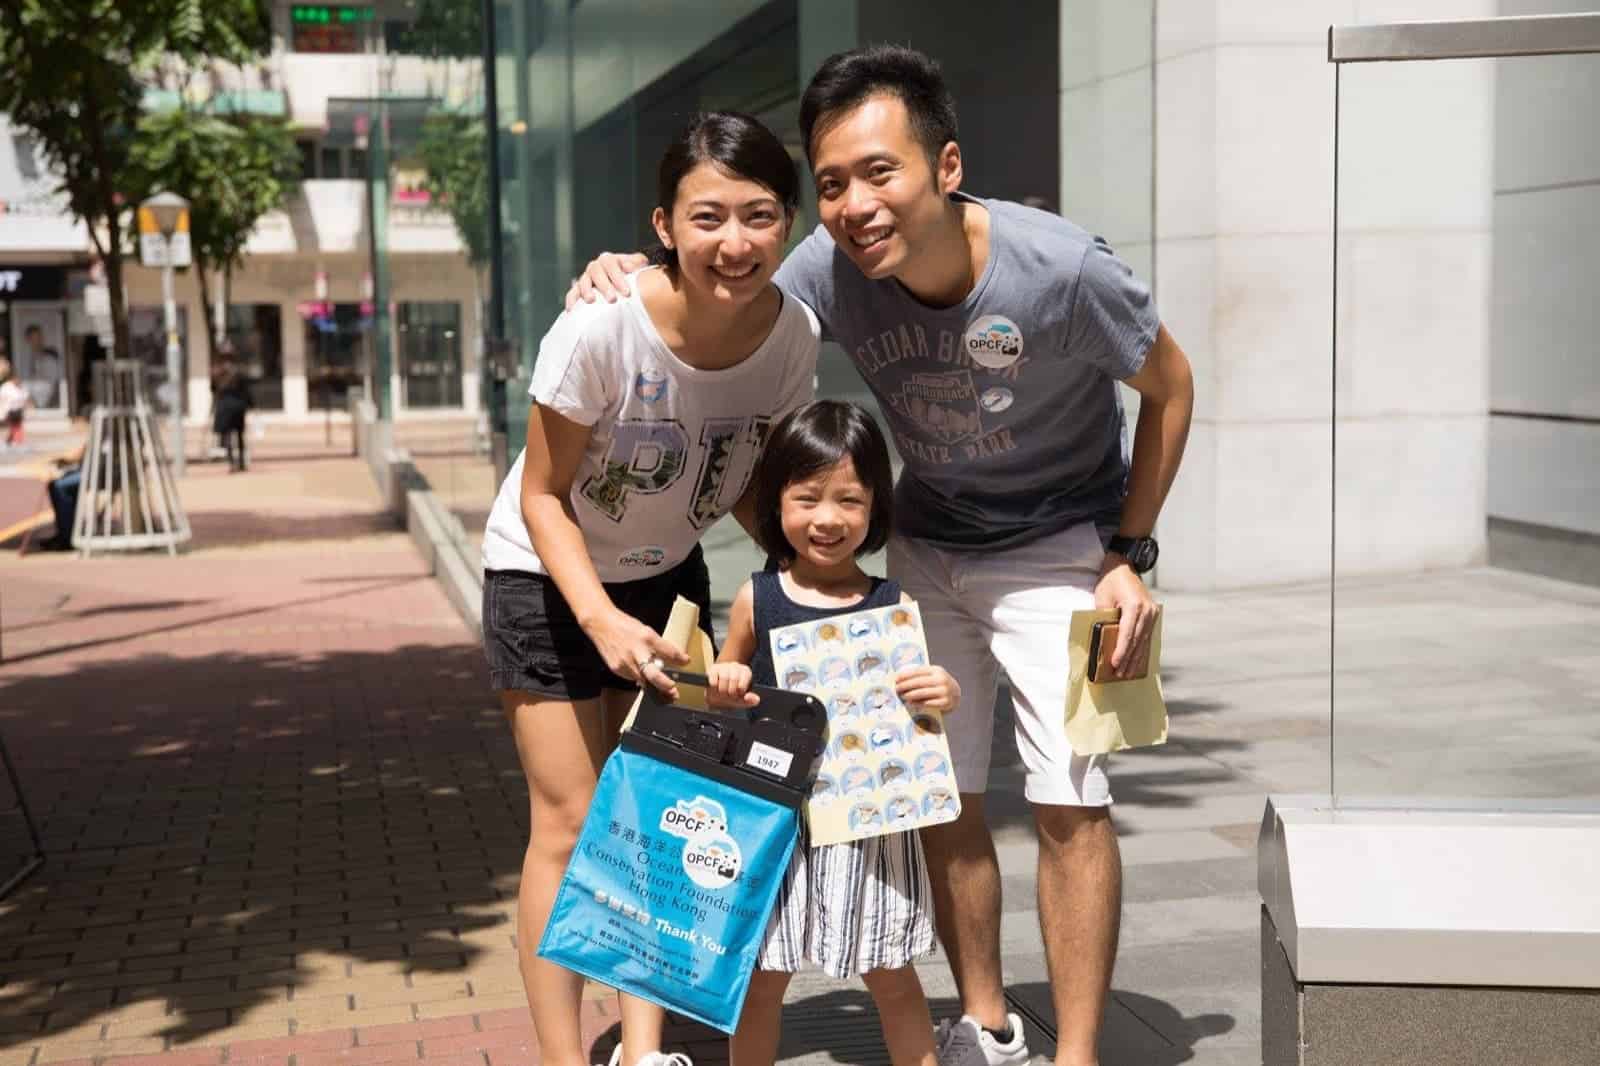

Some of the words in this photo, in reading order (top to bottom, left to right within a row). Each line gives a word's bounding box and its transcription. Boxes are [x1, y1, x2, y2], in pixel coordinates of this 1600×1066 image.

[856, 323, 928, 377] CEDAR
[969, 339, 1002, 350] OPCF
[756, 754, 780, 770] 1947
[665, 810, 705, 832] OPCF
[637, 851, 685, 876] Ocean
[687, 853, 721, 868] OPCF
[583, 841, 674, 890] Conservation
[680, 882, 761, 918] Foundation
[629, 879, 666, 908] Hong
[671, 895, 707, 922] Kong
[655, 917, 698, 945] Thank
[702, 933, 727, 957] You
